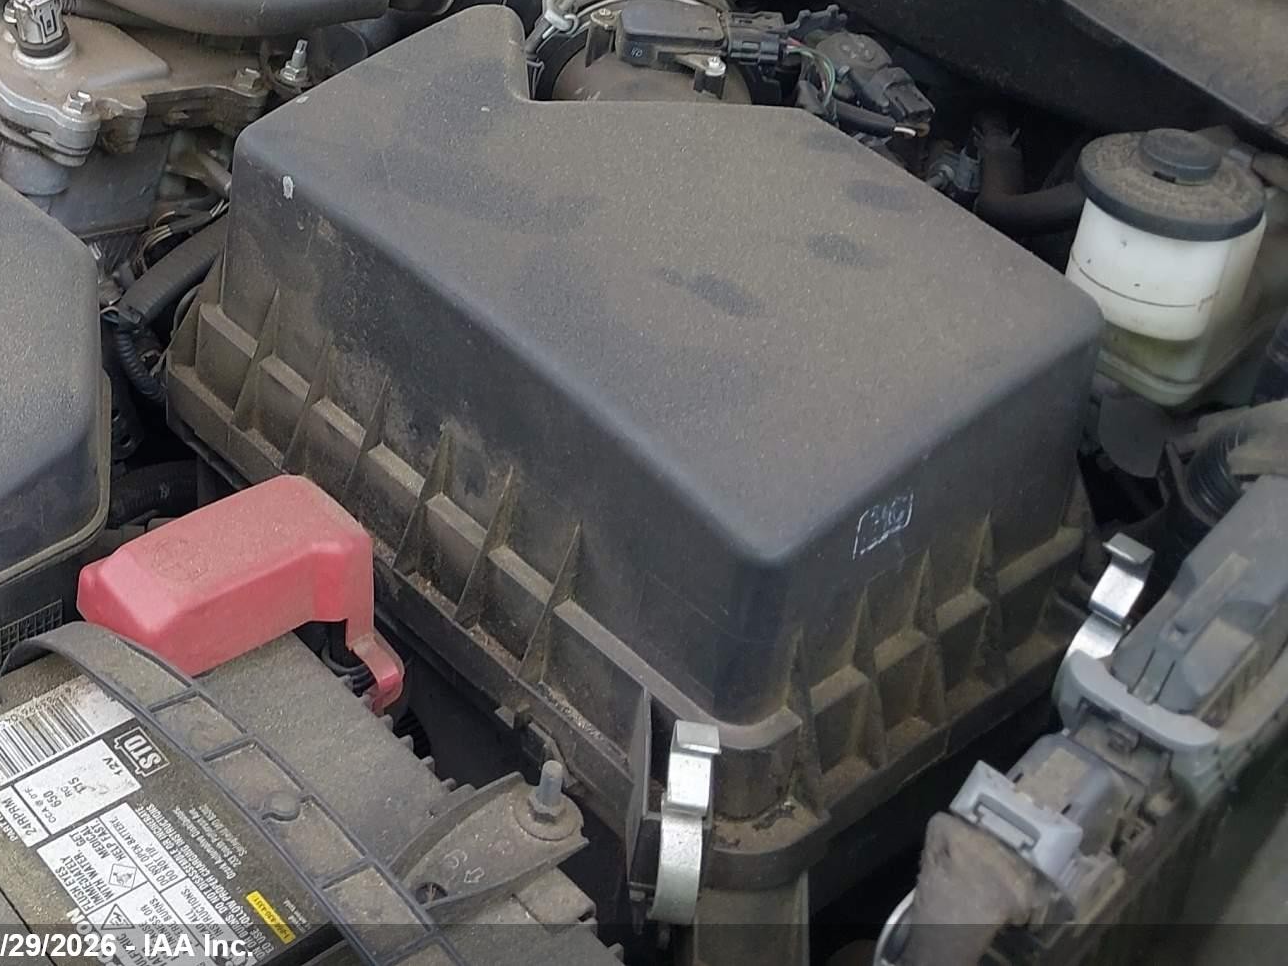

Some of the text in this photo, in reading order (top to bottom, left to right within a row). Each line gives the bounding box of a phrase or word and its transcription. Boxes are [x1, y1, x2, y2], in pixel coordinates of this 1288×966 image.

[121, 731, 163, 771] STD
[101, 754, 124, 777] 12V
[41, 789, 62, 808] 650
[59, 784, 73, 797] RC
[67, 775, 88, 795] 115
[1, 796, 37, 836] 24RPRM
[39, 806, 57, 824] CCA
[68, 829, 87, 847] GET
[78, 824, 110, 859] MEDICAL
[88, 819, 126, 861] HELP FAST.
[108, 815, 169, 886] DO NOT OPEN BATTERY.
[161, 837, 176, 850] OR
[70, 848, 99, 880] WATER.
[143, 842, 178, 881] DO NOT TIP.
[169, 846, 210, 892] DISASSEMBLE
[179, 842, 211, 878] CHARGING
[54, 865, 76, 887] EYES
[59, 853, 105, 906] IMMEDIATELY
[92, 877, 115, 900] WITH
[204, 873, 232, 902] PROPER
[69, 885, 94, 912] FLUSH
[146, 894, 172, 922] BURNS.
[203, 887, 220, 904] NOT
[213, 900, 228, 914] DO
[139, 903, 153, 916] OR
[184, 909, 200, 924] ALL
[226, 897, 254, 927] FOLLOW
[222, 910, 248, 938] BURNS.
